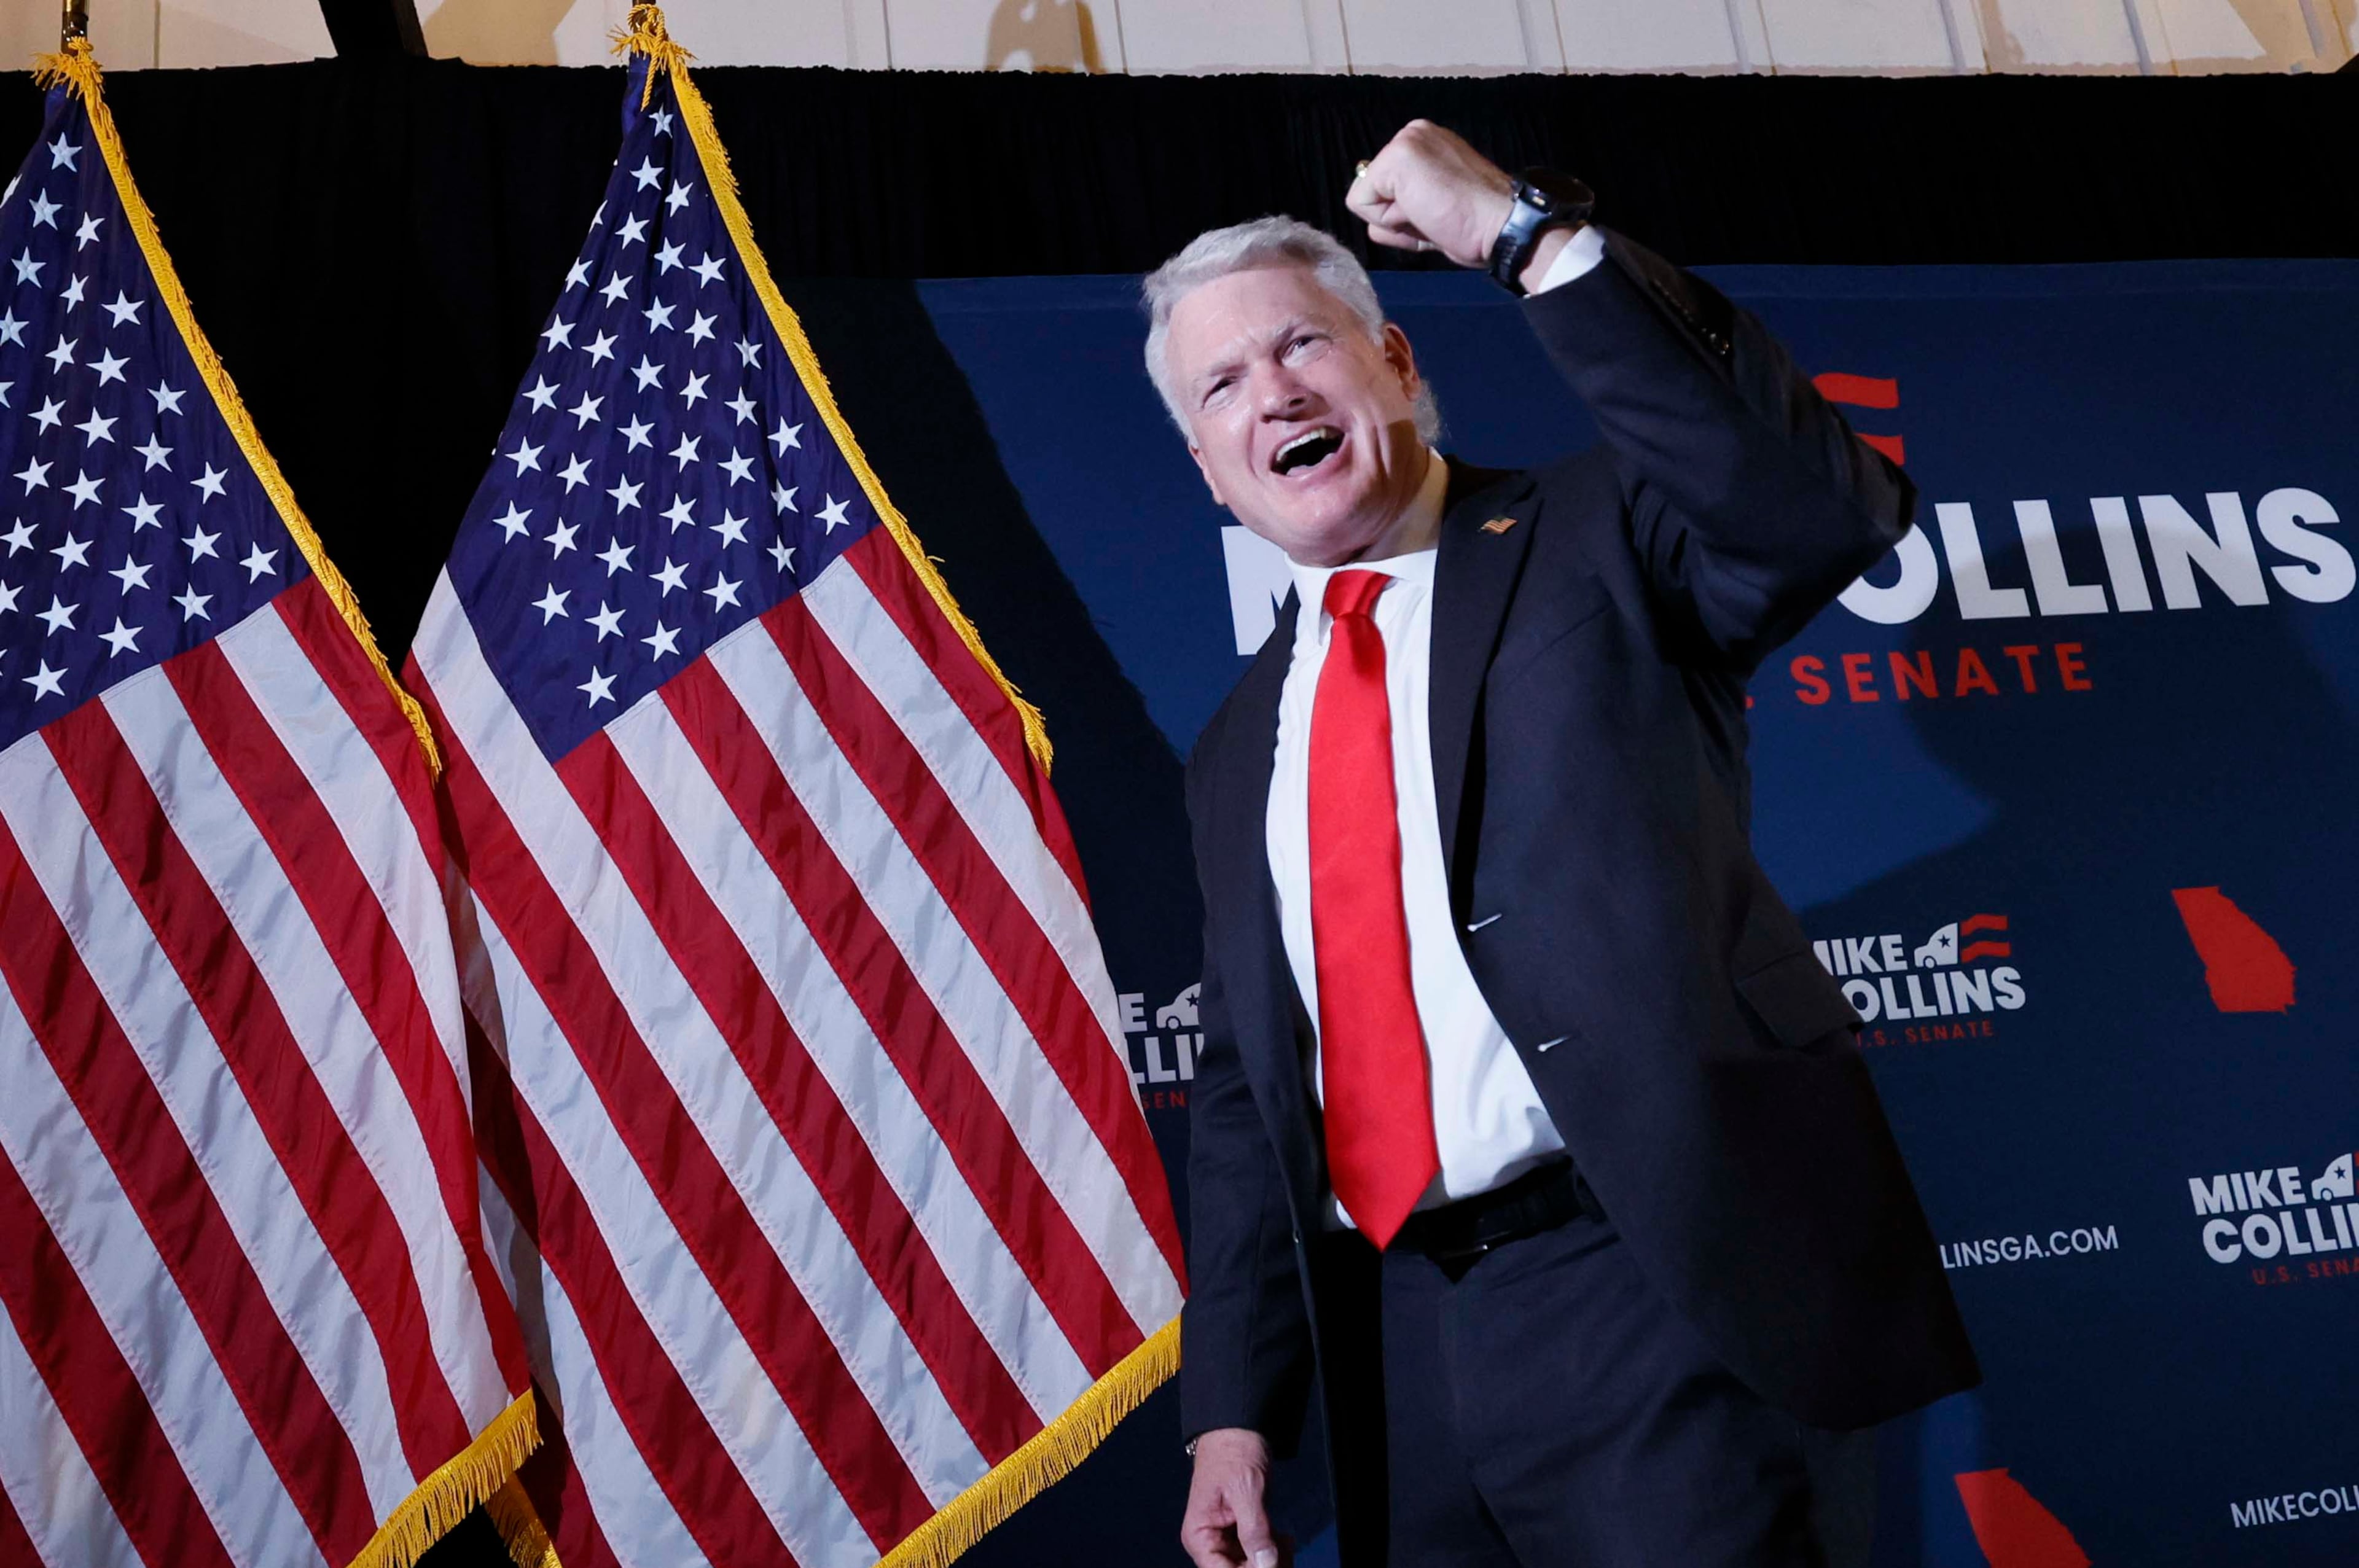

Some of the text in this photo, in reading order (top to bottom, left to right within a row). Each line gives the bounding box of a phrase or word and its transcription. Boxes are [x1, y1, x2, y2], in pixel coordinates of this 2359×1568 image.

[1790, 642, 2092, 705] SENATE
[1905, 1020, 1993, 1044] SENATE
[2188, 1166, 2306, 1215] MIKE
[1939, 1225, 2119, 1269] LINSGA.COM
[2252, 1265, 2300, 1285] U.S.
